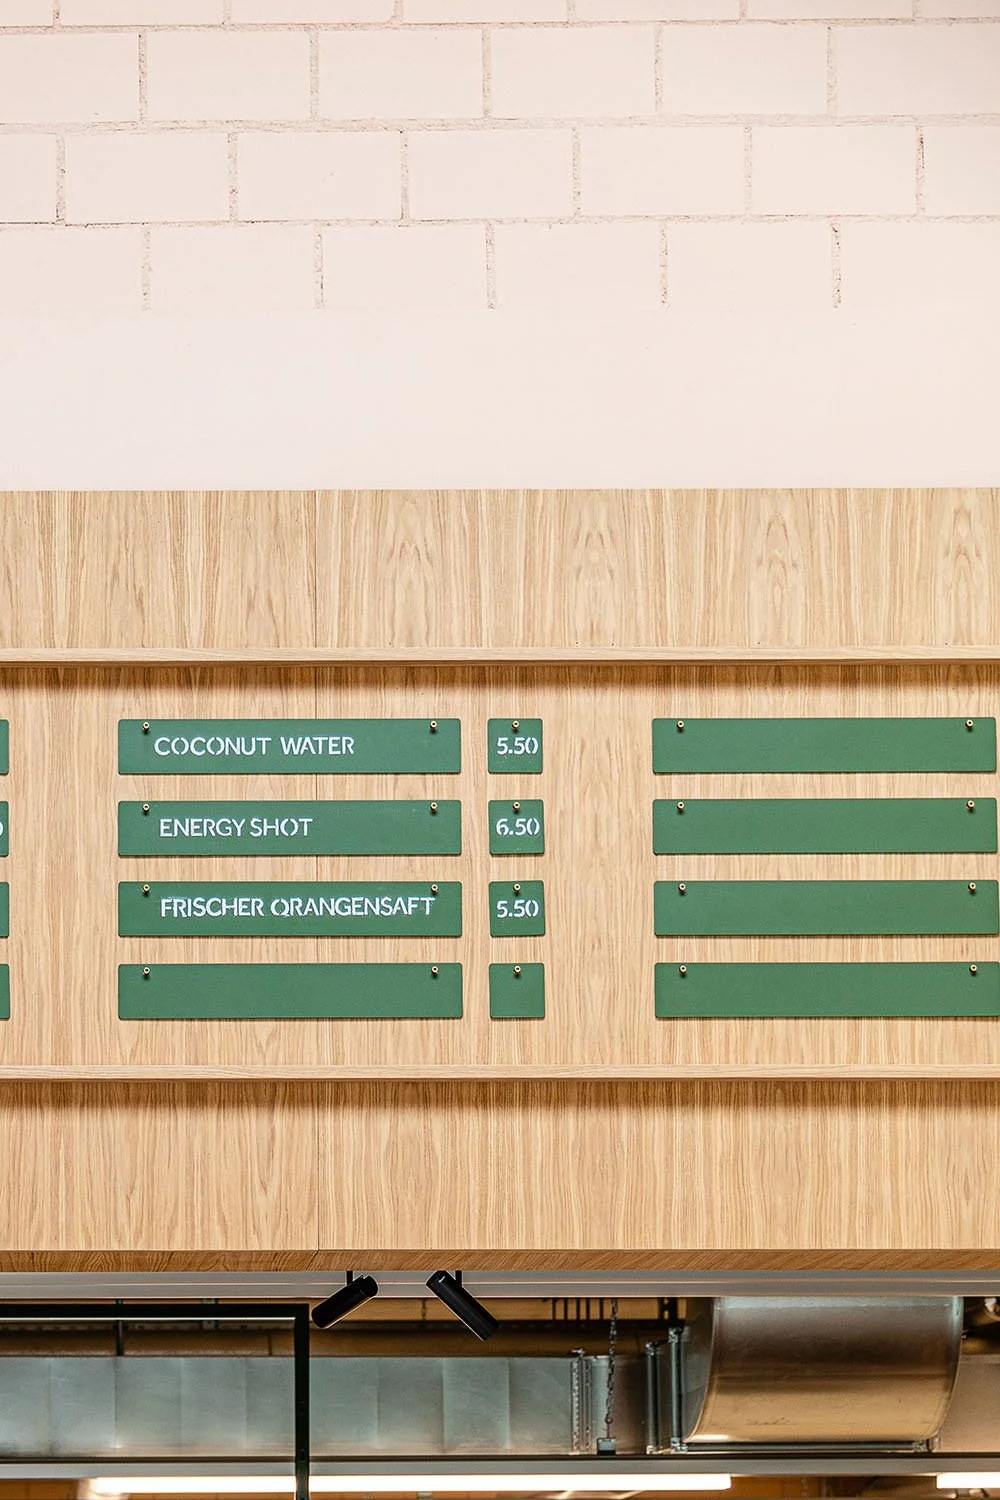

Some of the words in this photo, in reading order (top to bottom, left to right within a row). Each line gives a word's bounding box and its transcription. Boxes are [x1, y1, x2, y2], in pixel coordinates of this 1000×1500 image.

[154, 736, 272, 756] COCONUT
[280, 736, 355, 755] WATER
[496, 736, 539, 755] 5.50
[159, 817, 246, 837] ENERGY
[249, 817, 313, 838] SHOT
[495, 817, 540, 836] 6.50
[160, 896, 265, 918] FRISCHER
[270, 896, 436, 917] ORANGENSAFT
[496, 899, 539, 918] 5.50
